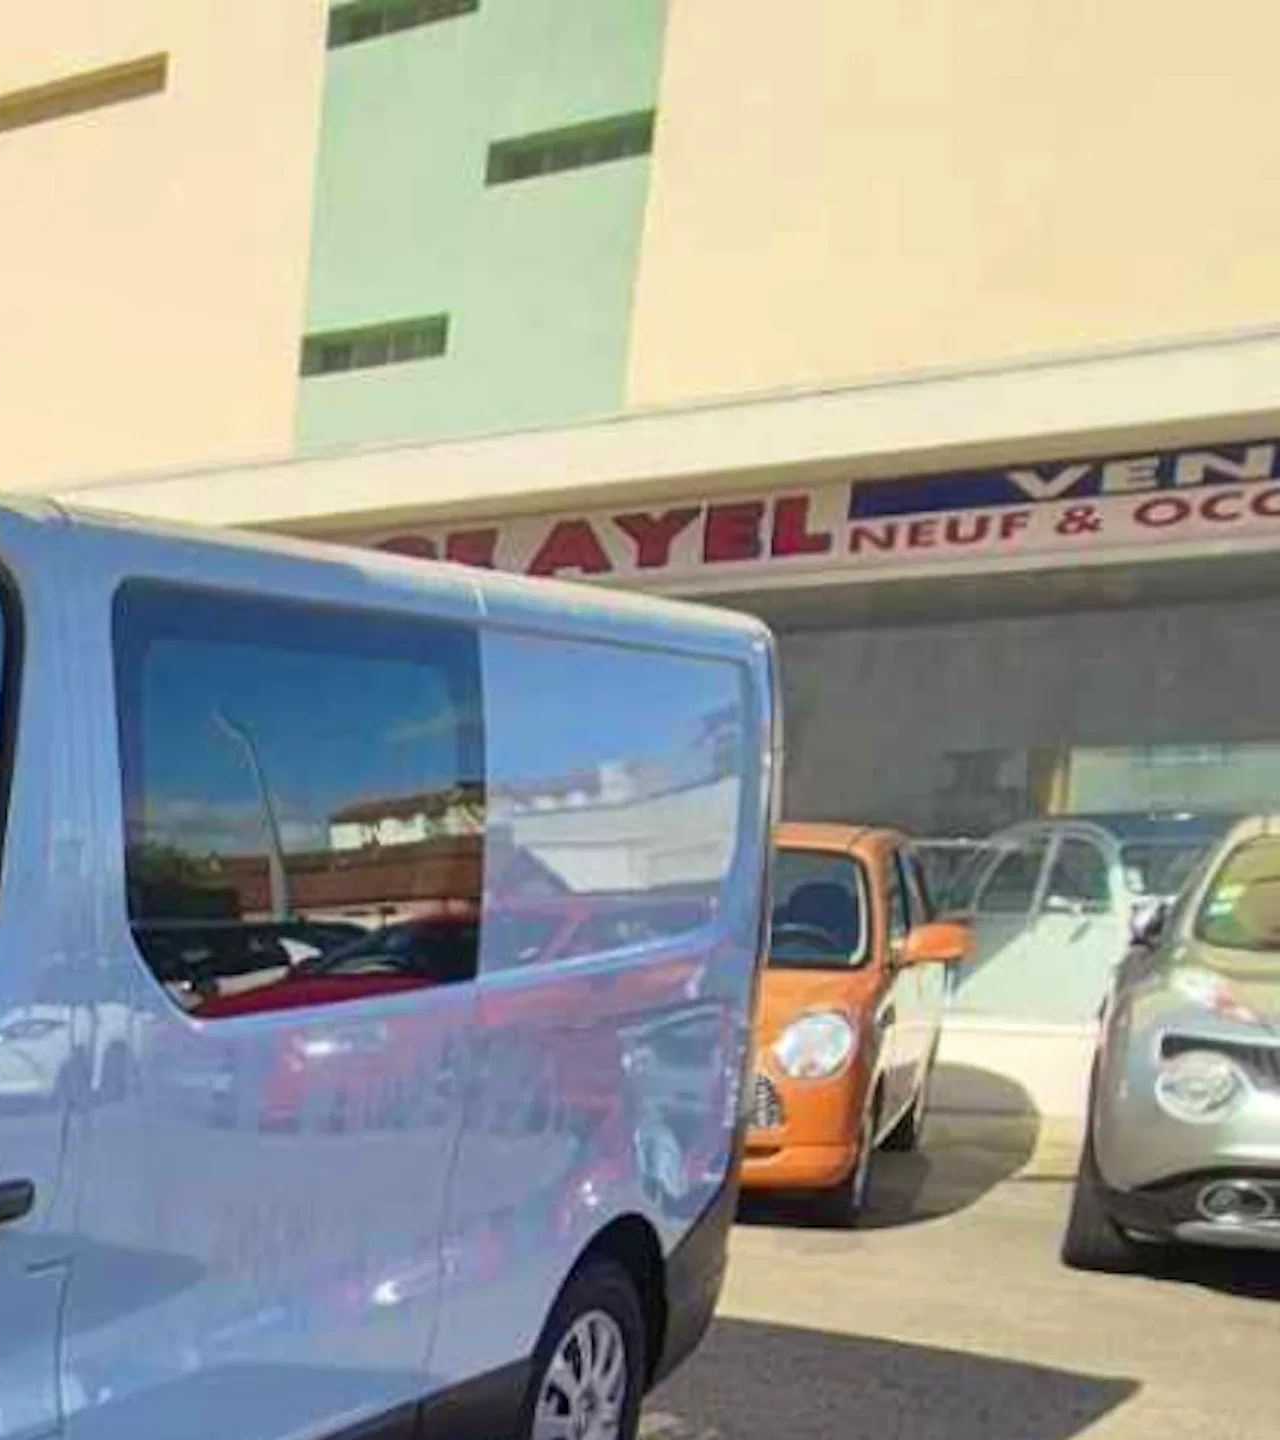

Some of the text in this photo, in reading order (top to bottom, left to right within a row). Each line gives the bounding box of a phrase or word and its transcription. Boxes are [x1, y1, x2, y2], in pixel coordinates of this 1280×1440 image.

[1005, 444, 1276, 500] VEN
[849, 510, 1033, 555] NEUF
[1053, 503, 1105, 537] &
